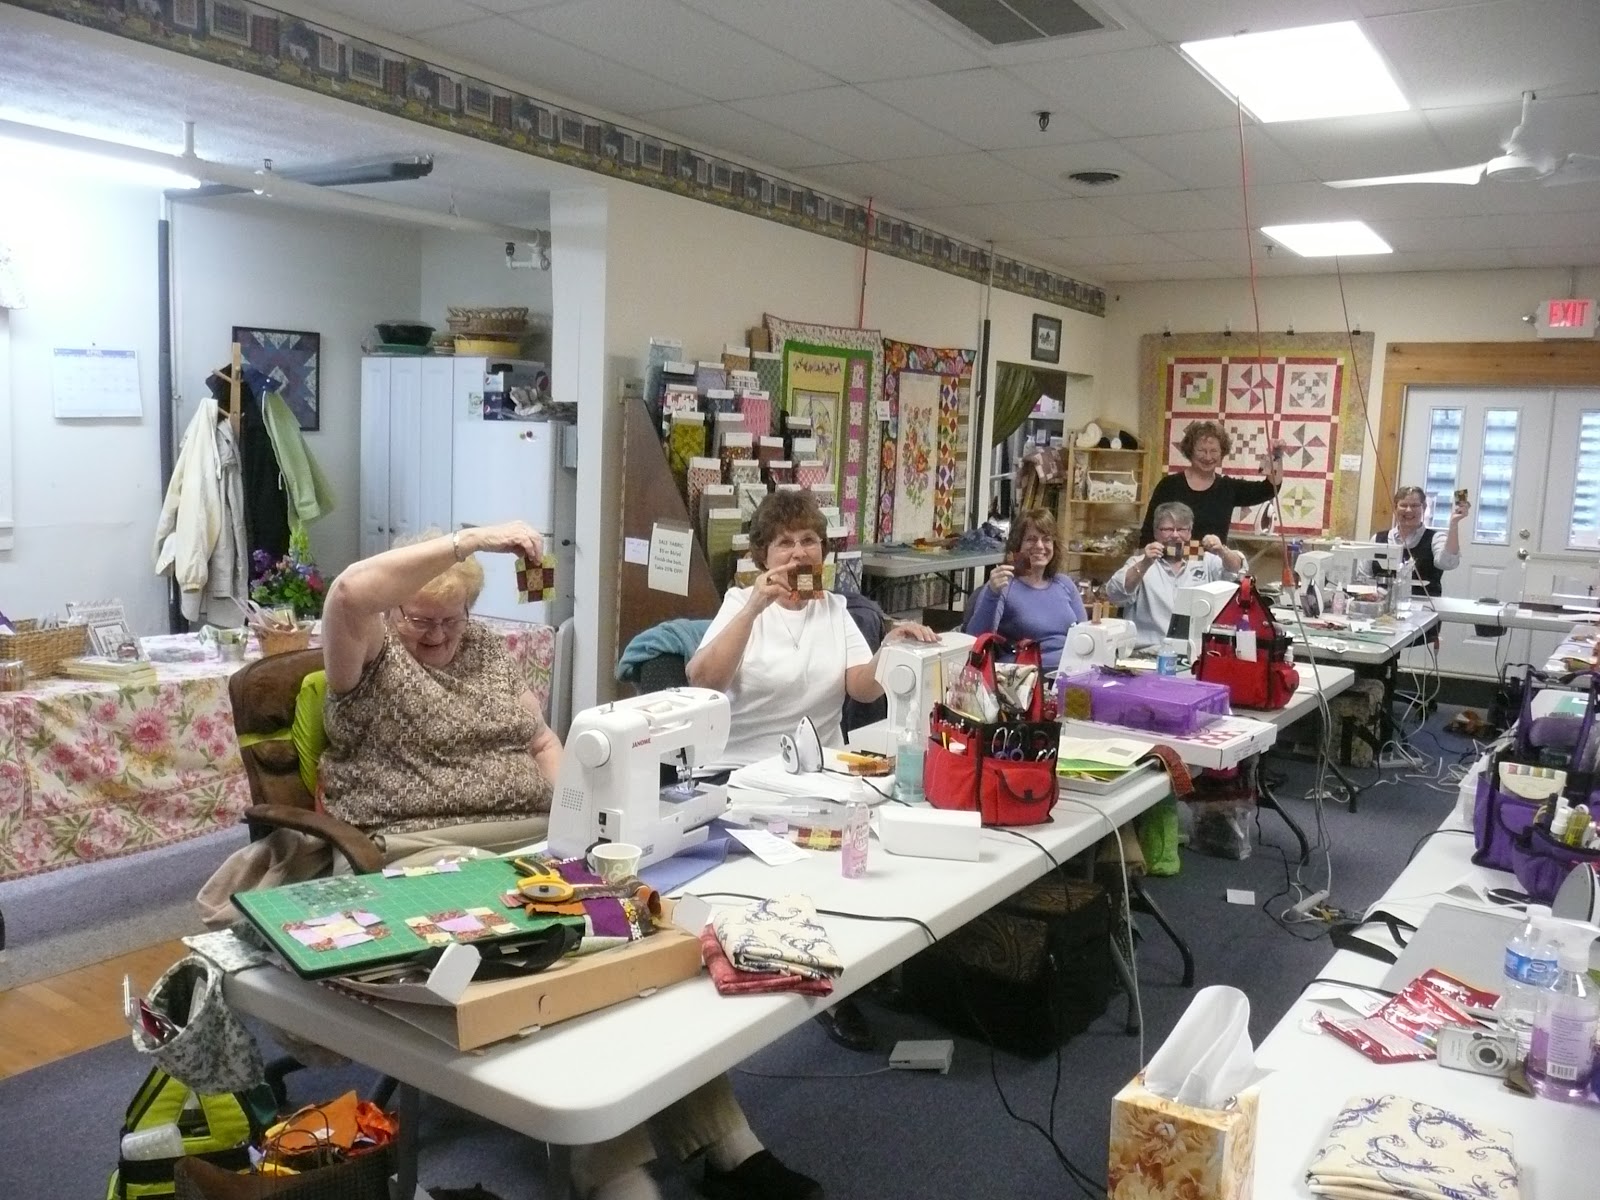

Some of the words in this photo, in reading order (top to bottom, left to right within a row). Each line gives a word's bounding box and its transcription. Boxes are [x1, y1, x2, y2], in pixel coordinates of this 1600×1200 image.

[1549, 302, 1588, 327] EXIT
[669, 541, 684, 549] FABRIC
[632, 738, 651, 748] JANOME
